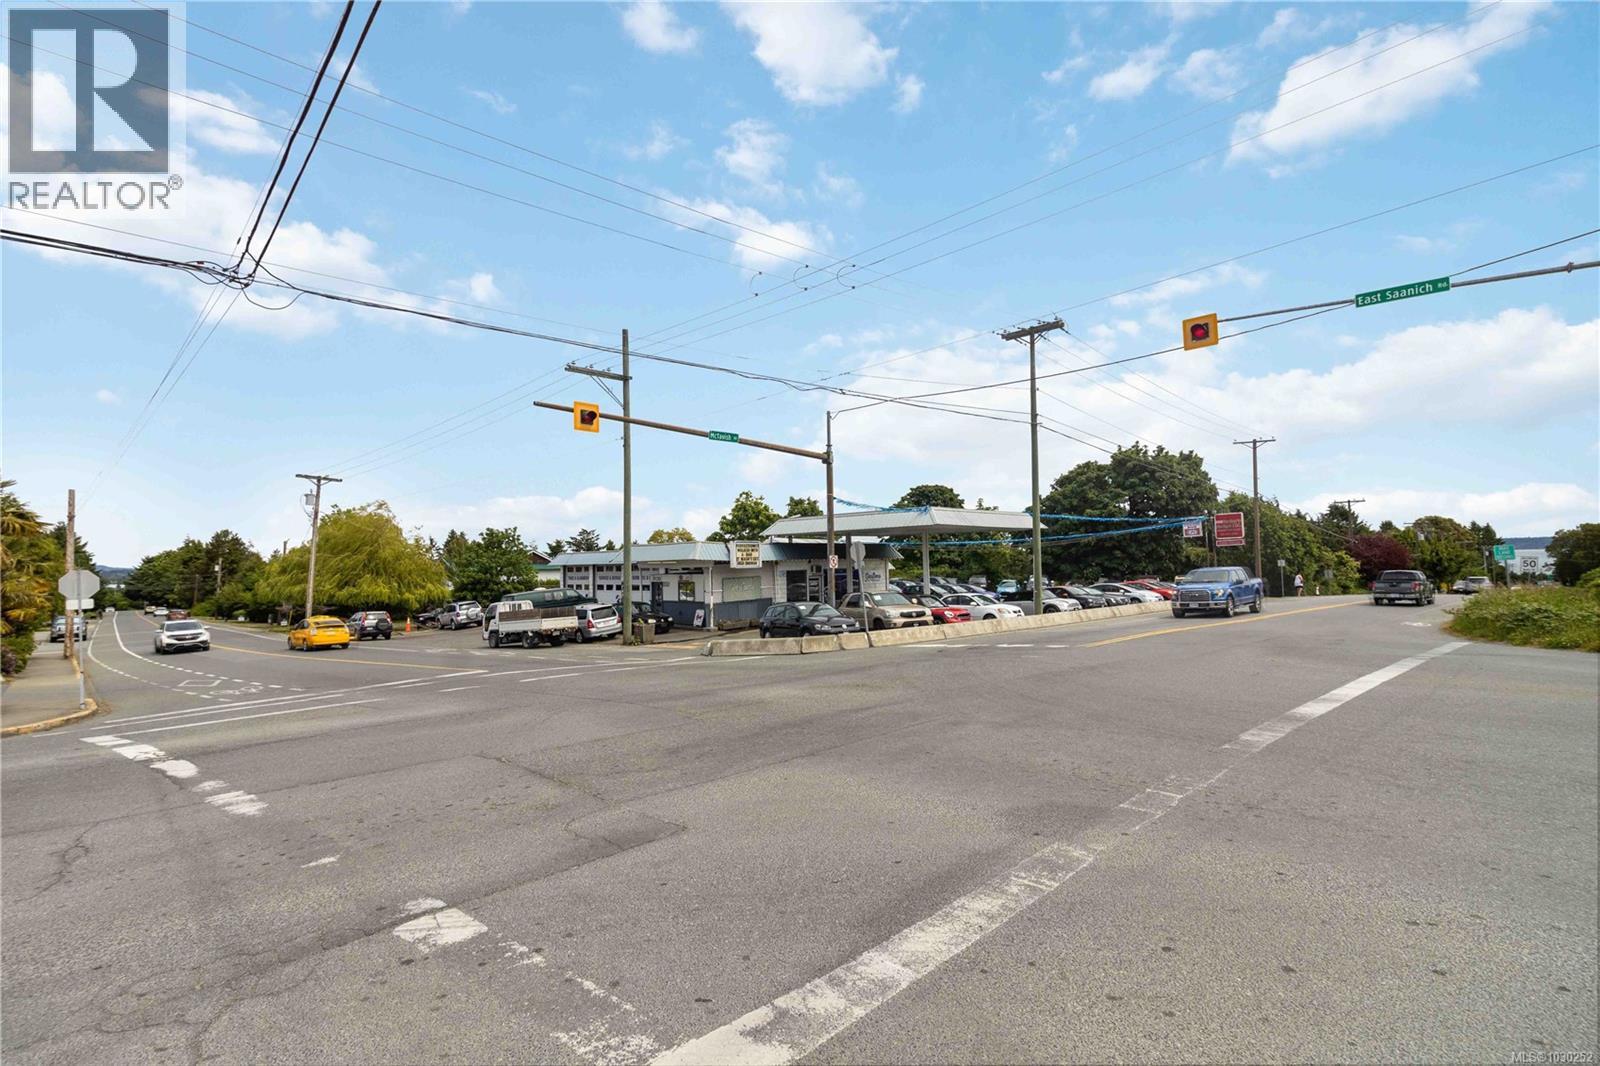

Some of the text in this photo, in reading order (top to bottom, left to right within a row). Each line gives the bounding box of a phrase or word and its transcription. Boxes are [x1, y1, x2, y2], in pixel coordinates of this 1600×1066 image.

[1358, 293, 1381, 306] East
[1385, 283, 1433, 300] Saanich
[1523, 560, 1537, 568] 50
